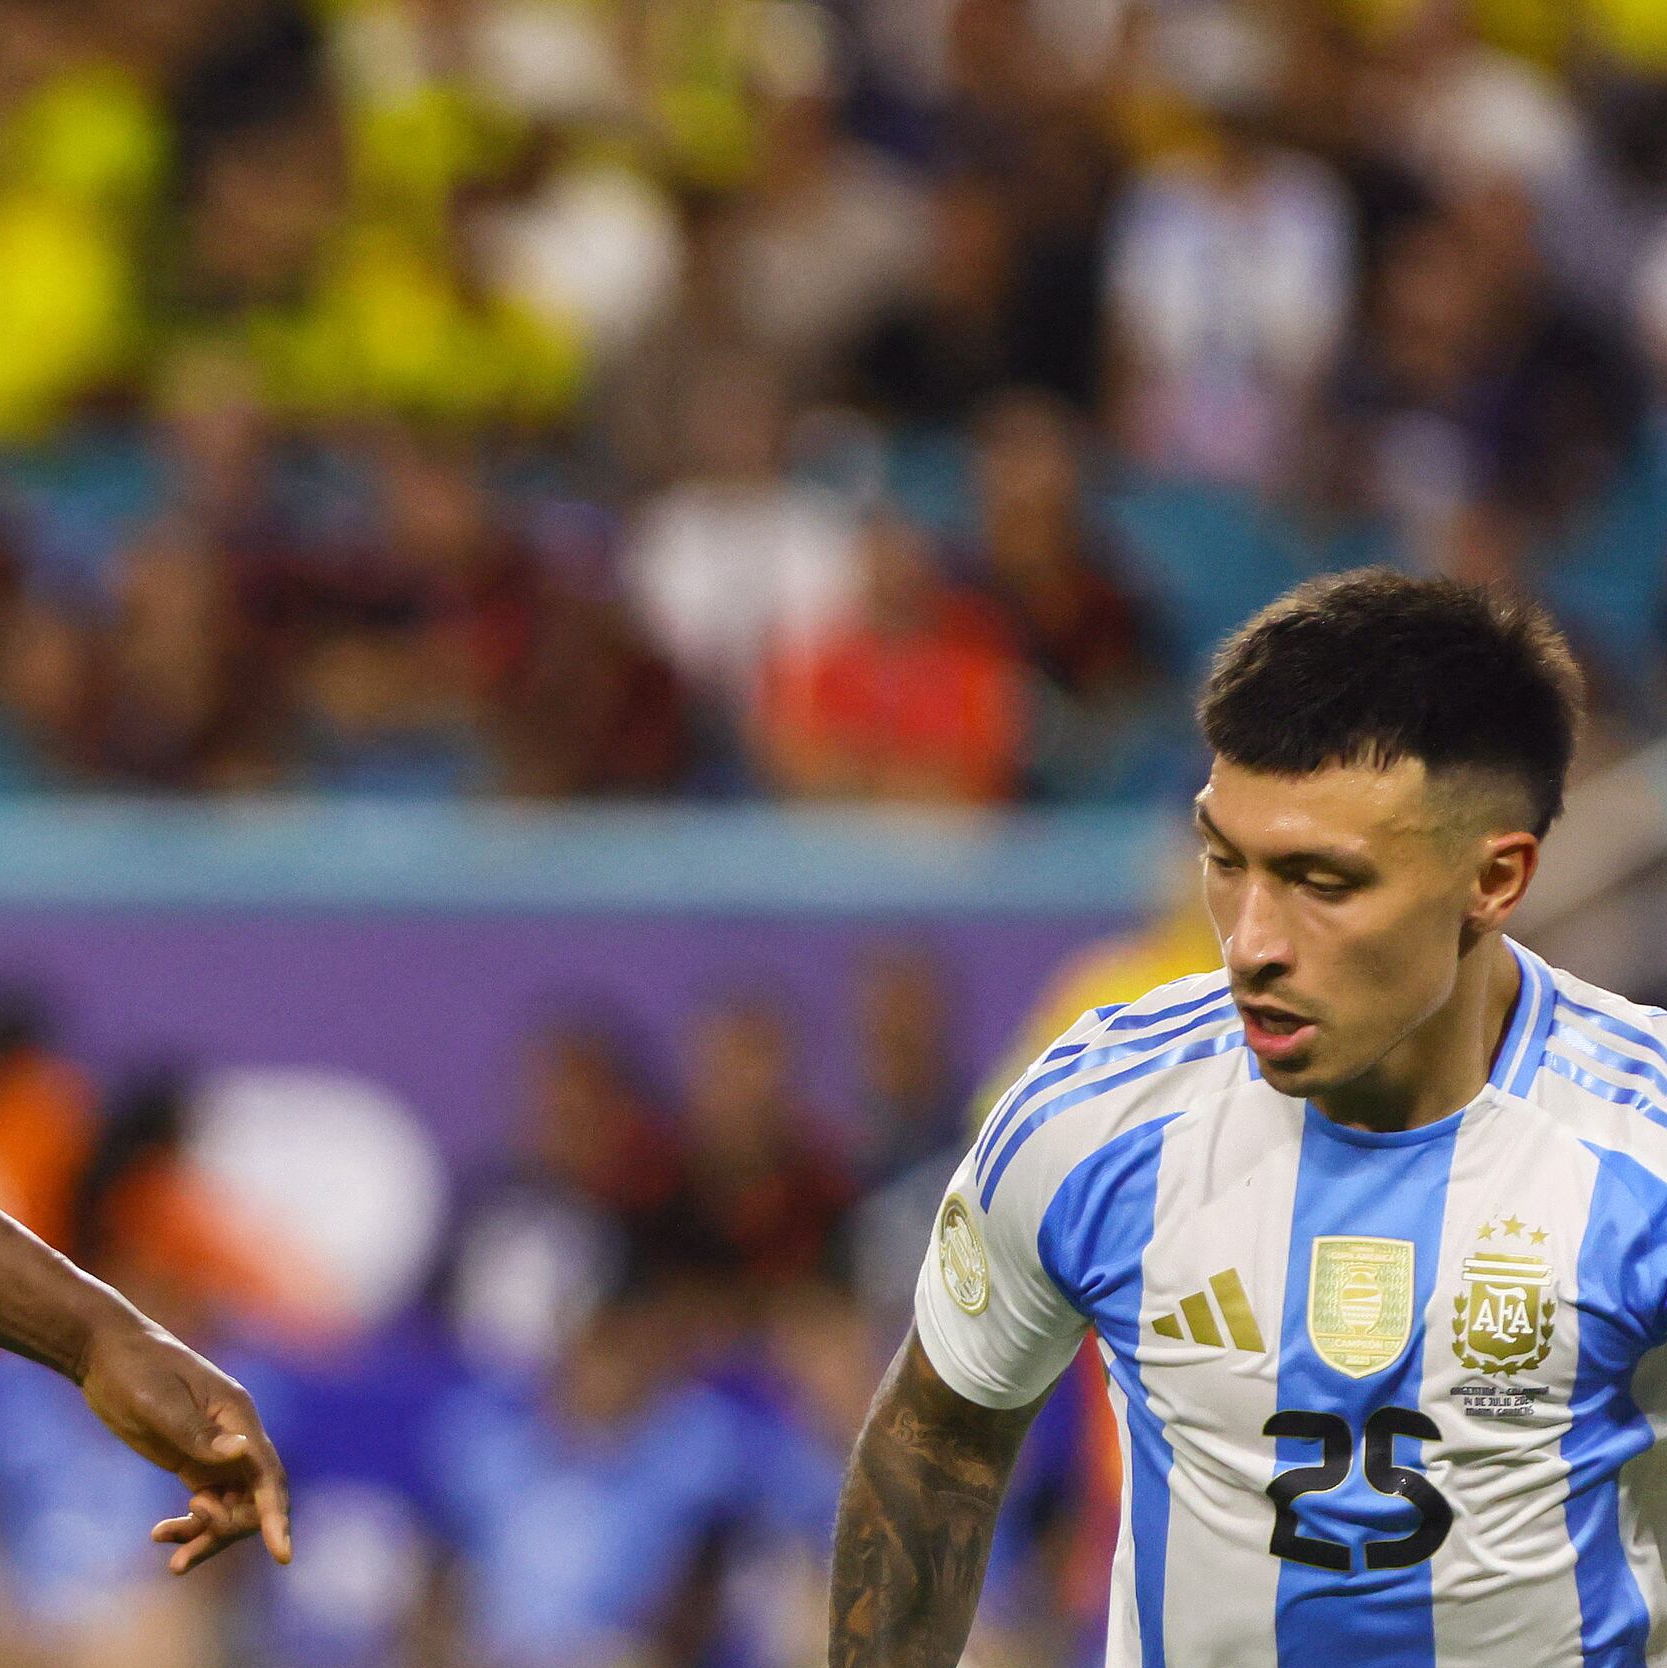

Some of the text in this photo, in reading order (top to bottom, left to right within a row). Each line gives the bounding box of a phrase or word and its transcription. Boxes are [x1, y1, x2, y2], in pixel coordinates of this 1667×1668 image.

[1471, 1284, 1534, 1344] AFA
[1474, 1397, 1486, 1406] DE
[1488, 1397, 1512, 1407] JULIO
[1263, 1406, 1454, 1572] 25
